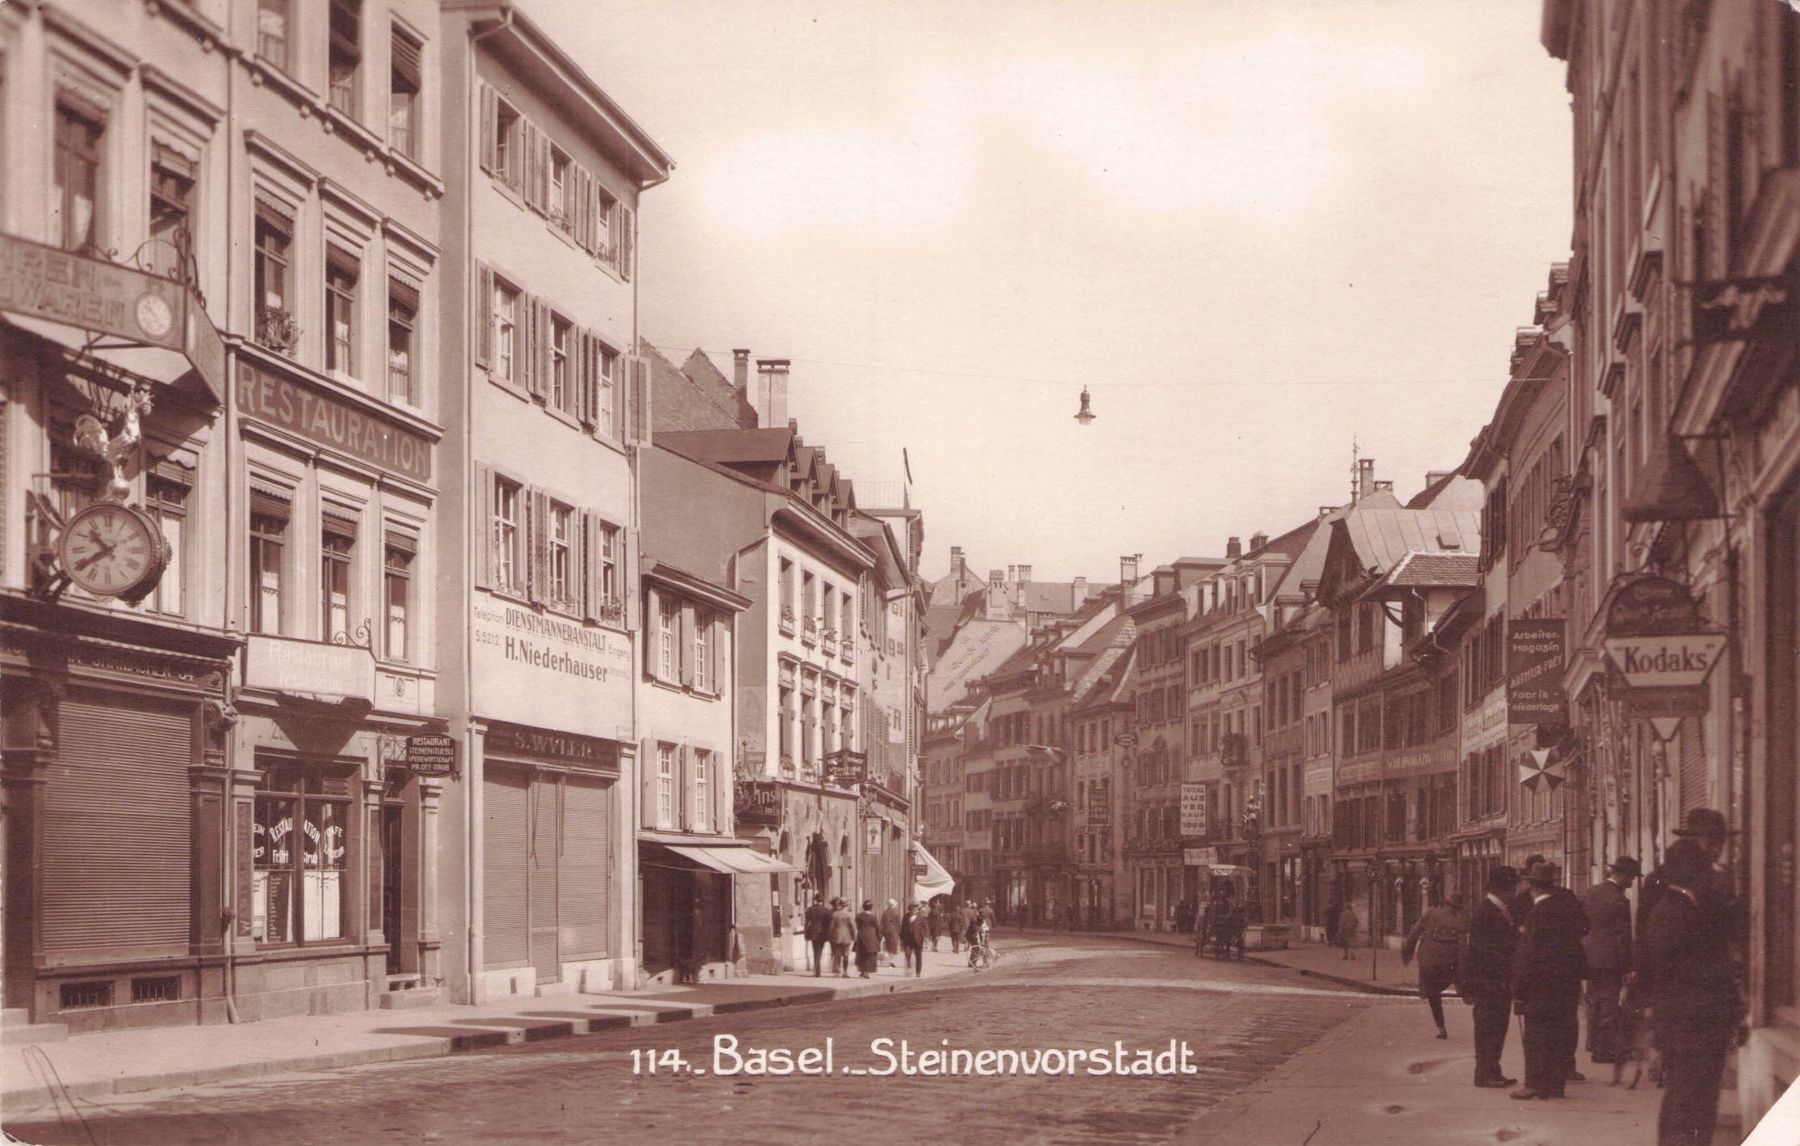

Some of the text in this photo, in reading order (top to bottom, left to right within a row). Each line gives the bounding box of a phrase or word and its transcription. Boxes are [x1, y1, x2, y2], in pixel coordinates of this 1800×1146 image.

[239, 361, 428, 478] RESTAURATION
[1624, 645, 1708, 674] Kodaks
[412, 737, 450, 746] RESTAURANT
